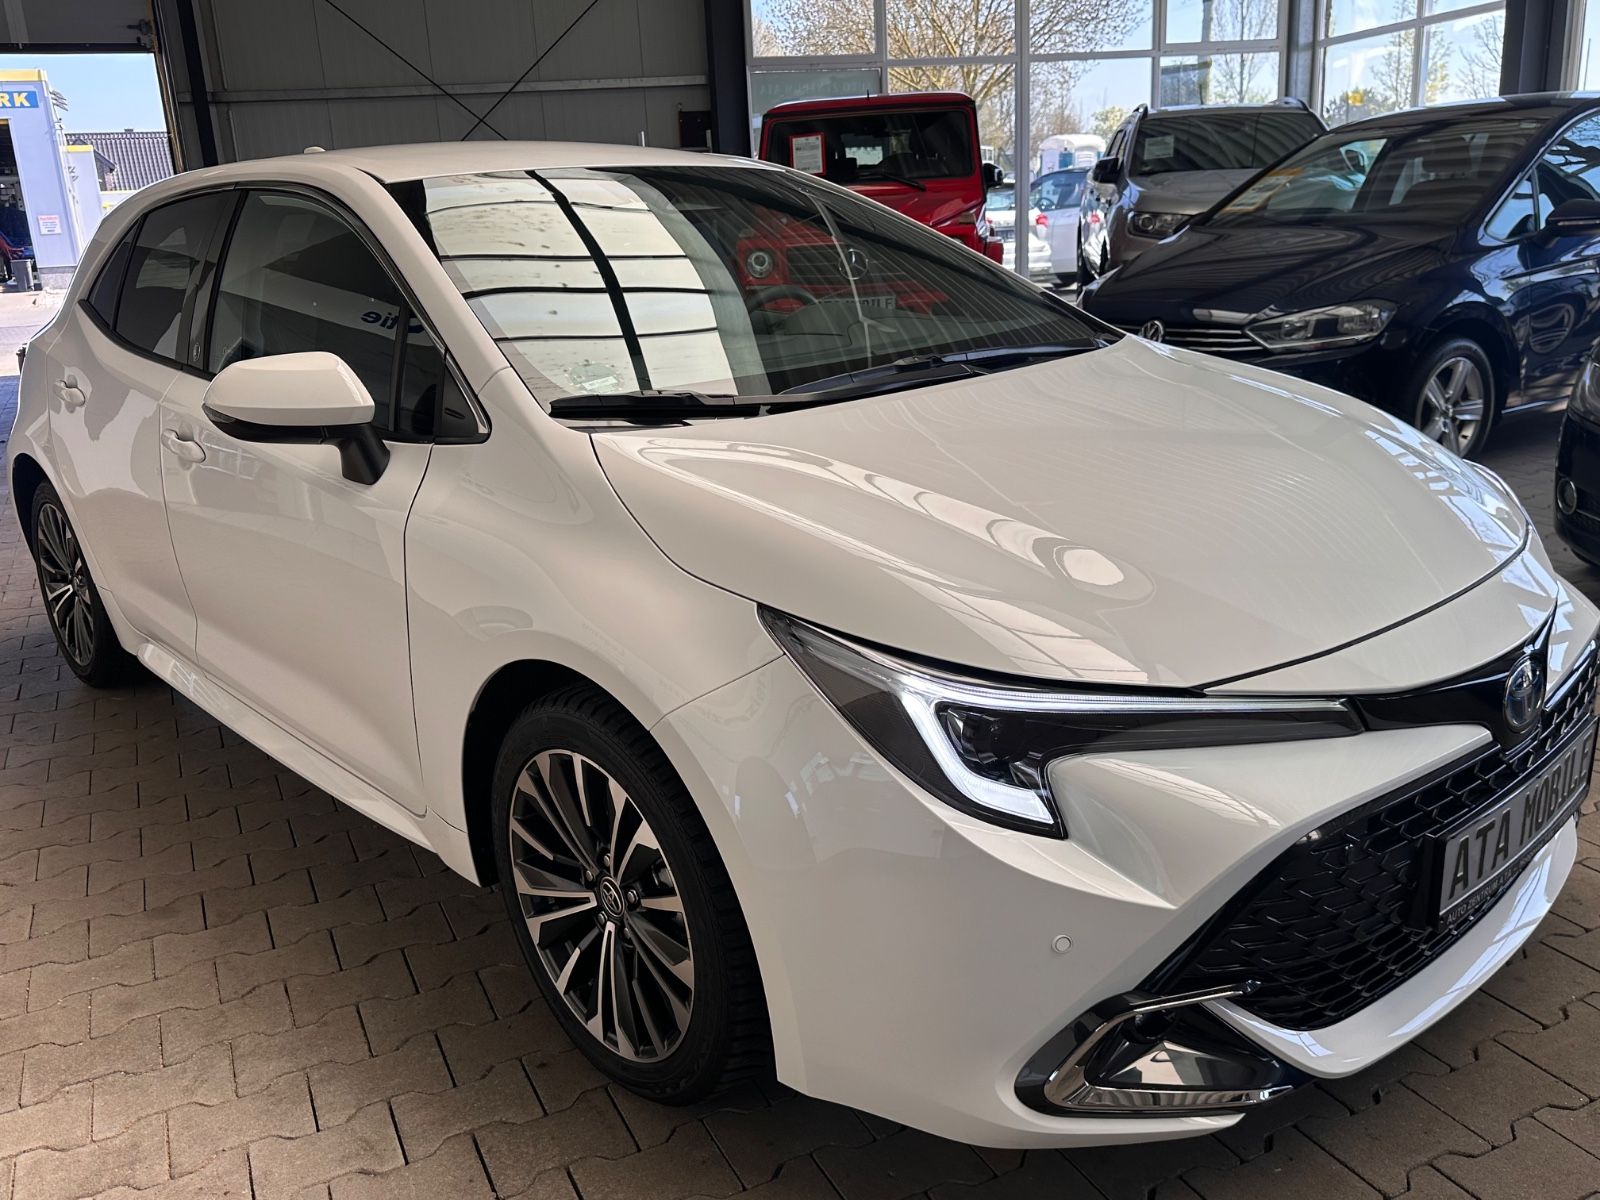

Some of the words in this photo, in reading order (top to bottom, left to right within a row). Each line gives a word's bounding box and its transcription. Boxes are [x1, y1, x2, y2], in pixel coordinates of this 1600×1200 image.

[1448, 807, 1511, 901] ATA
[1519, 729, 1593, 847] MOBILE
[1446, 903, 1467, 925] AUTO
